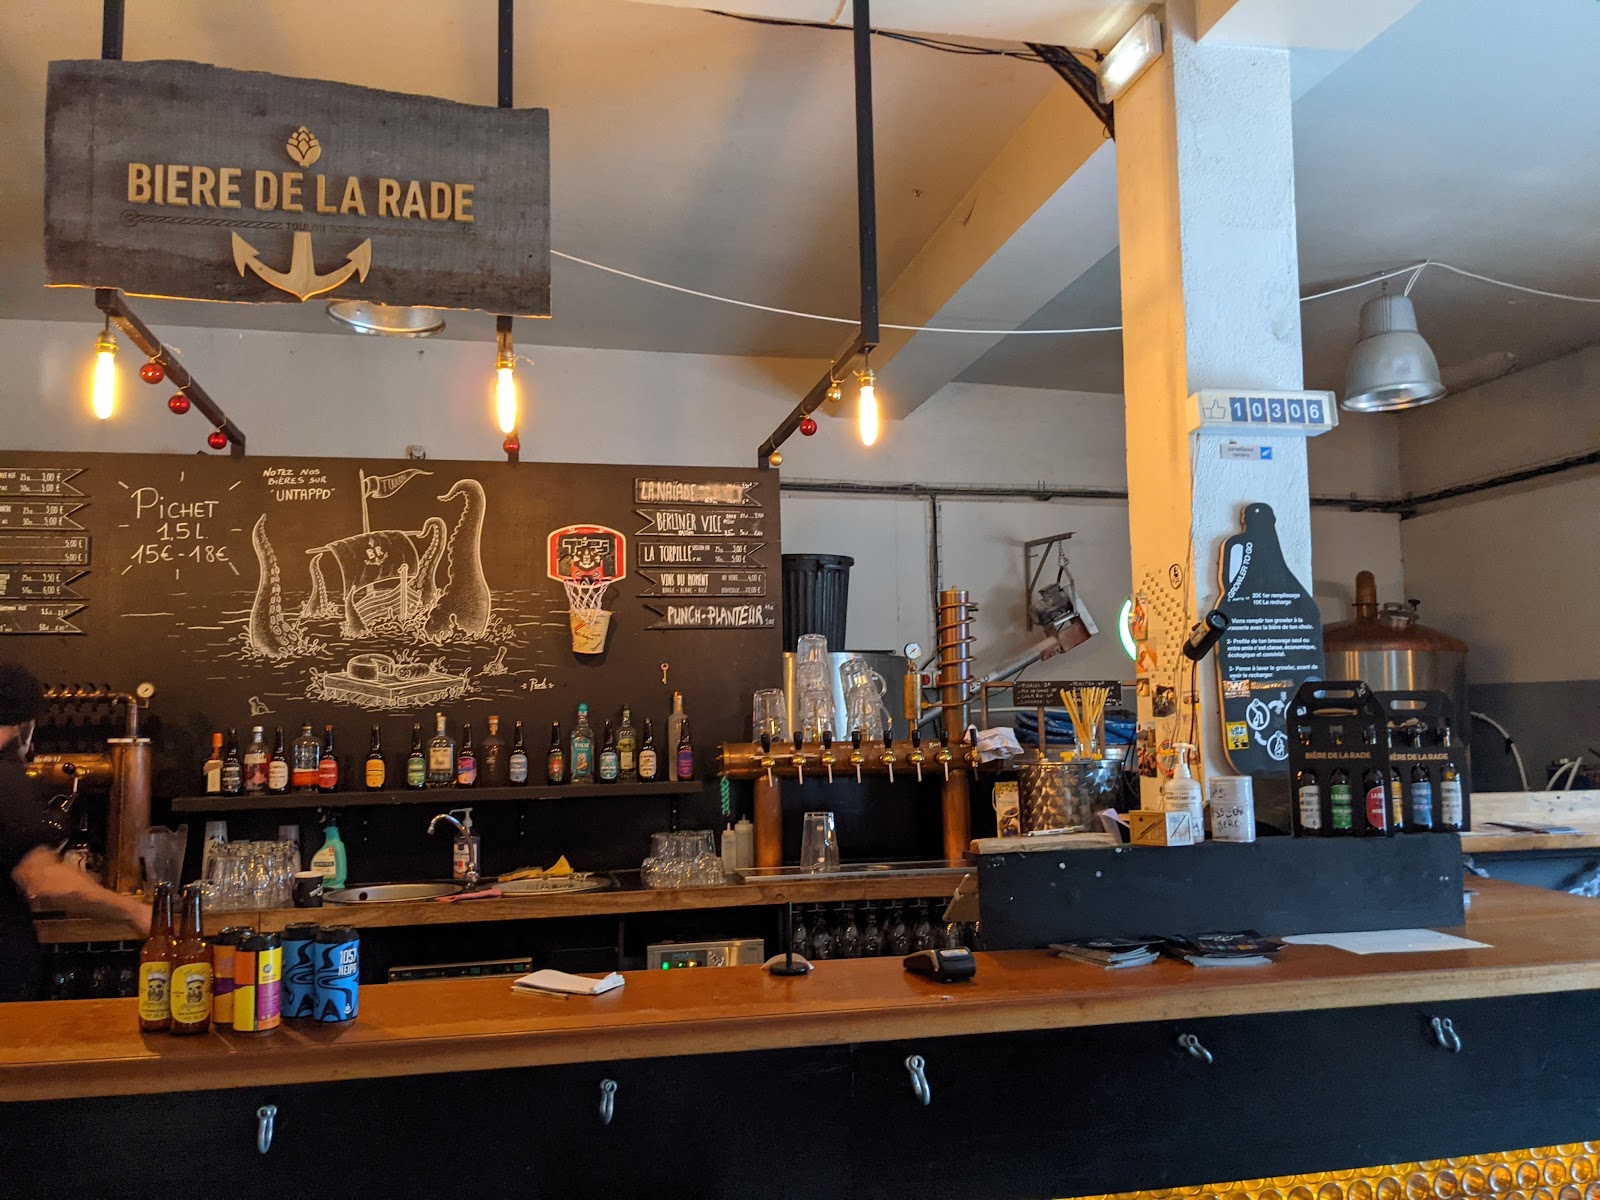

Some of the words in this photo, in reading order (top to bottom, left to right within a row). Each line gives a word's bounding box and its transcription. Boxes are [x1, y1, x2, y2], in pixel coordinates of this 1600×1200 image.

[127, 163, 241, 208] BIERE
[254, 170, 304, 212] DE
[316, 174, 366, 217] LA
[378, 178, 475, 222] RADE
[263, 467, 294, 477] NOTEZ
[308, 476, 328, 485] SUR
[656, 512, 697, 531] BERLINER
[701, 514, 722, 533] VICE
[1245, 541, 1253, 555] GO
[644, 545, 655, 562] LA
[659, 545, 692, 562] TORPILLE
[1243, 554, 1251, 565] TO
[660, 573, 675, 586] VINS
[677, 574, 685, 586] DU
[687, 573, 709, 587] MOMENT
[1227, 564, 1249, 599] GROWLER
[1271, 592, 1301, 600] remplissage
[1270, 599, 1292, 607] recharge
[1246, 617, 1265, 625] remplir
[1274, 617, 1294, 625] growler
[1268, 637, 1291, 645] breuvage
[1227, 651, 1256, 659] écologique
[1305, 751, 1327, 760] BIÈRE
[1327, 752, 1338, 760] DE
[1407, 753, 1417, 761] DE
[1418, 753, 1428, 761] LA
[340, 949, 357, 965] 1057
[338, 963, 357, 976] NEIPA
